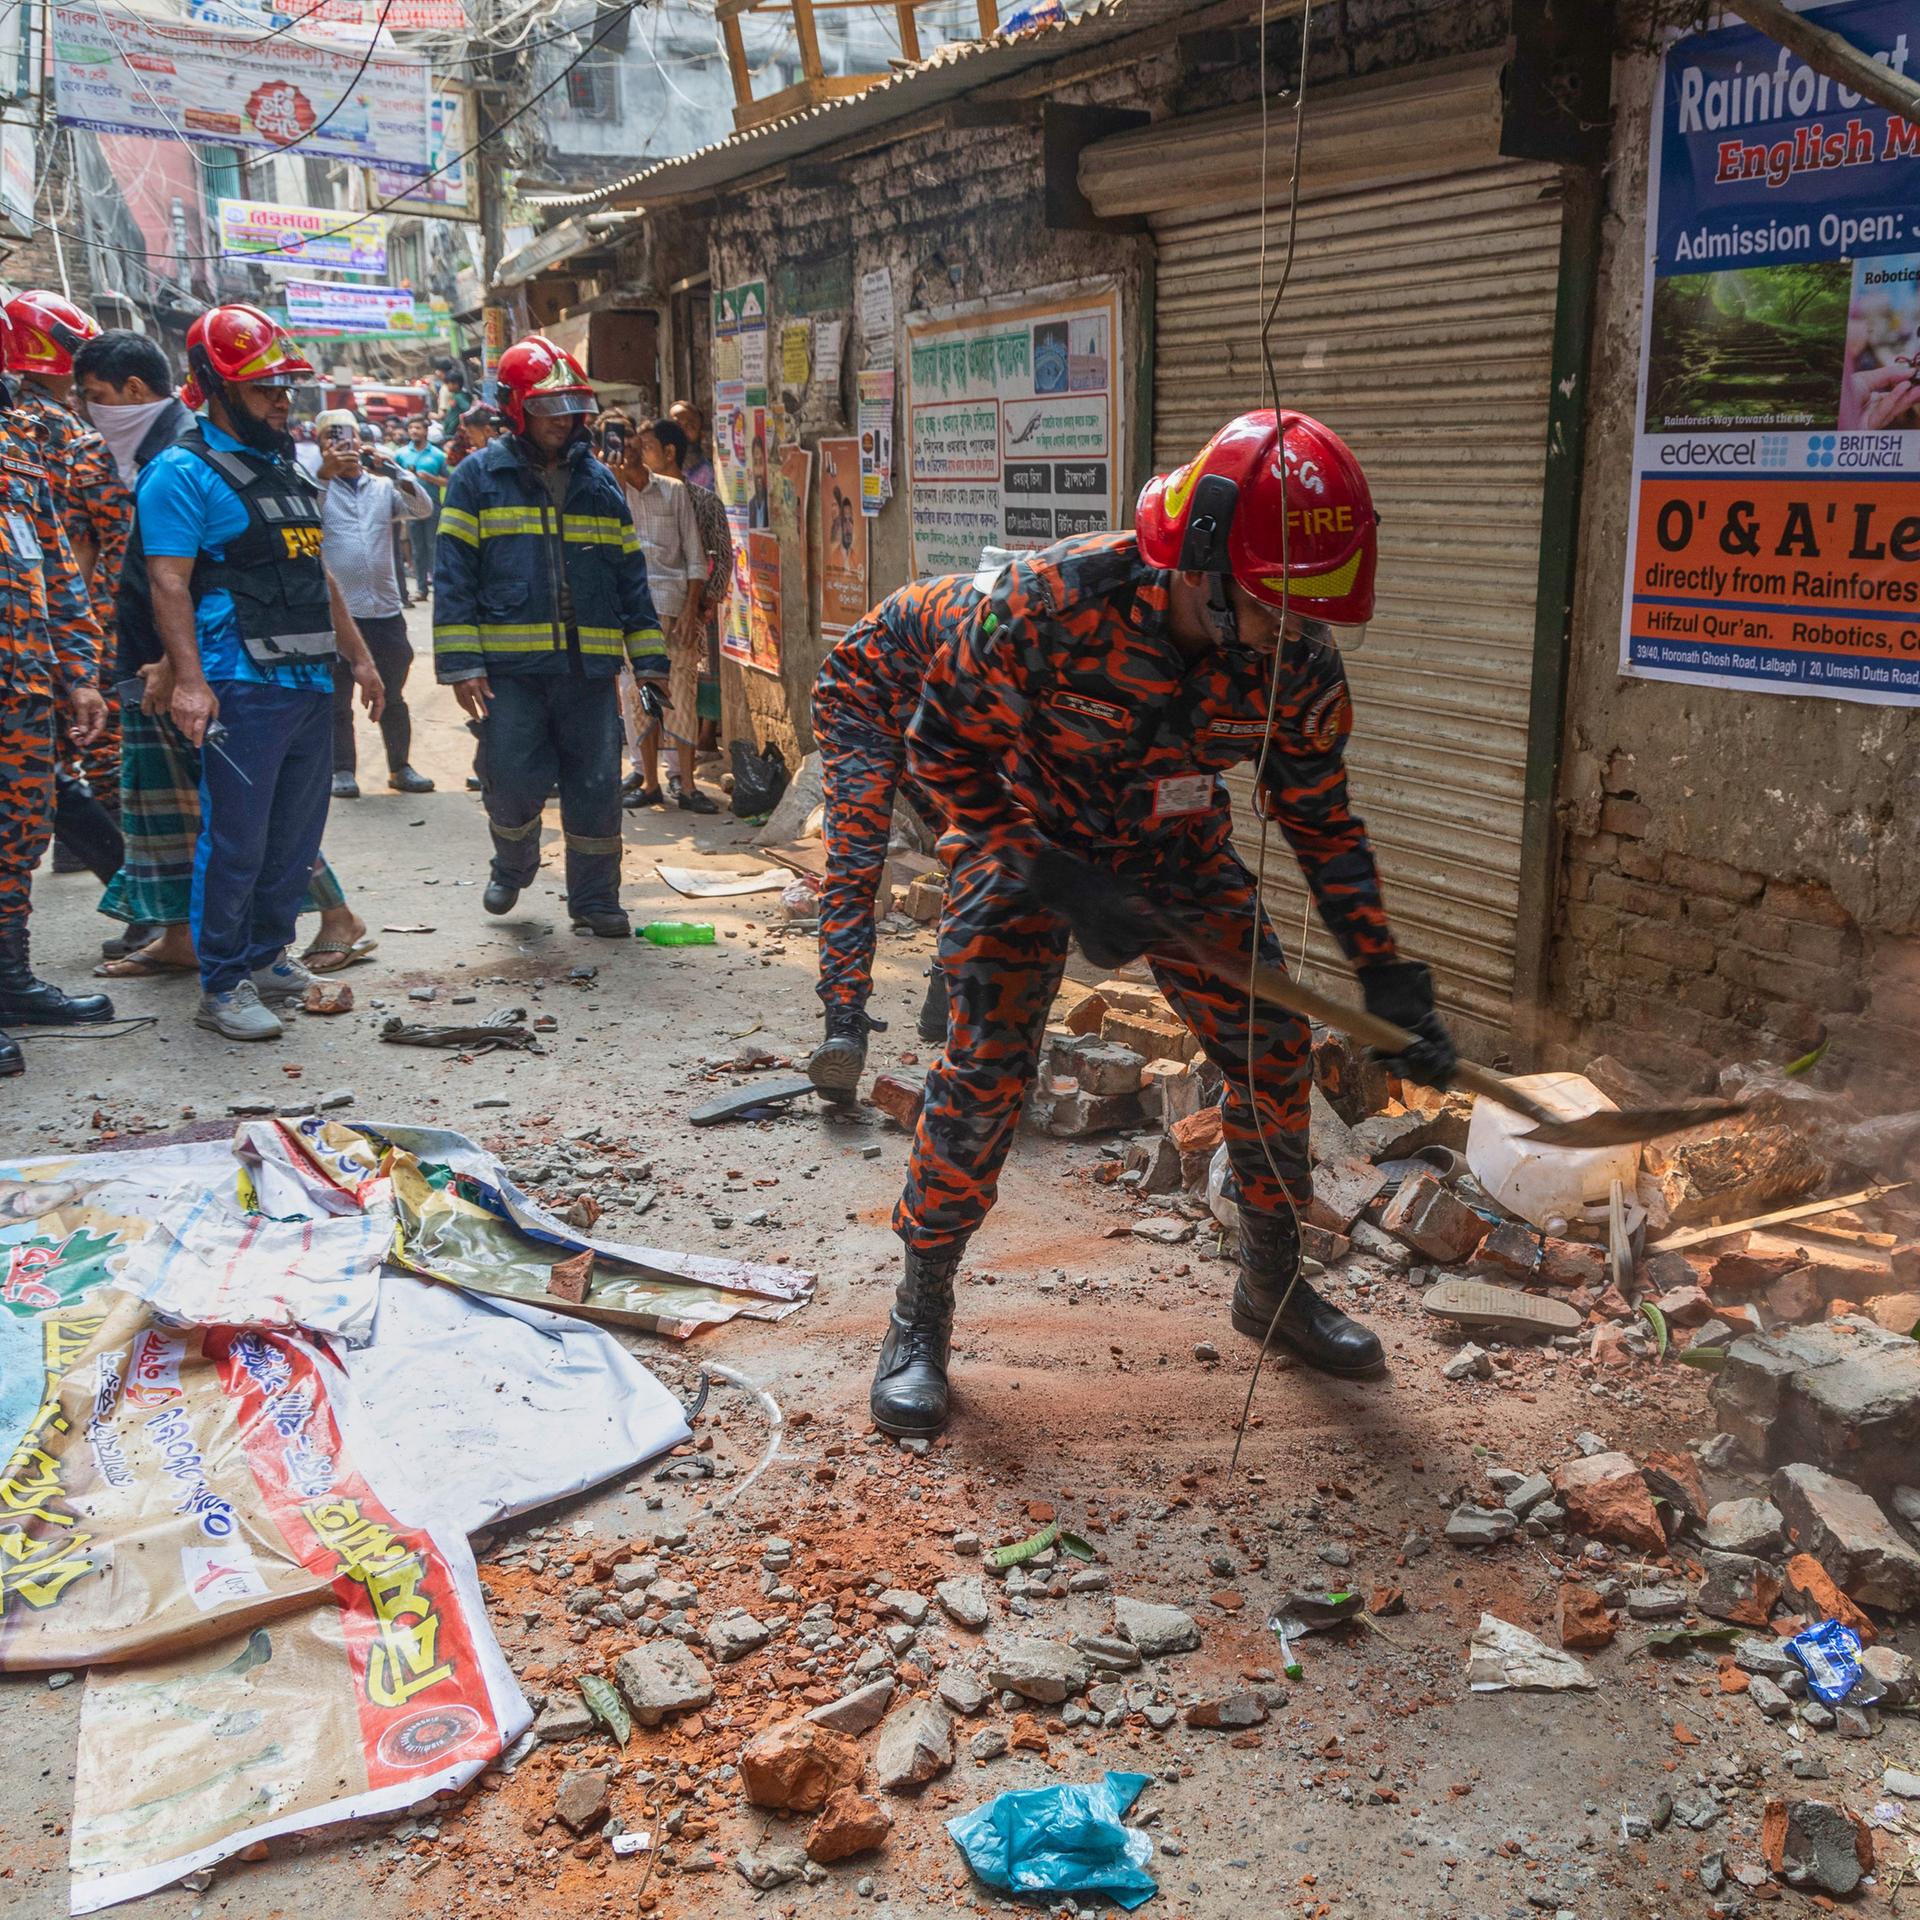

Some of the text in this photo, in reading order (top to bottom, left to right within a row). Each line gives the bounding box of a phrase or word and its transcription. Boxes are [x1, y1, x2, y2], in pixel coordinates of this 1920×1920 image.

[1715, 119, 1874, 188] English
[1675, 213, 1904, 262] Admission Open:
[1735, 414, 1775, 427] towards
[1776, 413, 1792, 424] the
[1661, 439, 1756, 465] edexcel
[1837, 451, 1903, 467] COUNCIL
[1840, 435, 1903, 450] BRITISH
[1286, 505, 1354, 535] FIRE
[1719, 500, 1760, 557] &
[1645, 563, 1728, 597] directly
[1732, 566, 1786, 595] from
[1647, 611, 1698, 633] Hifzul
[1792, 623, 1893, 653] Robotics,
[1900, 629, 1920, 651] C
[1636, 645, 1660, 661] 39/40,
[1661, 645, 1700, 663] Horonath
[1702, 650, 1731, 667] Ghosh
[1732, 653, 1759, 672] Road,
[1760, 657, 1797, 678] Lalbagh
[1809, 663, 1824, 678] 20,
[1826, 664, 1860, 680] Umesh
[1862, 667, 1890, 683] Dutta
